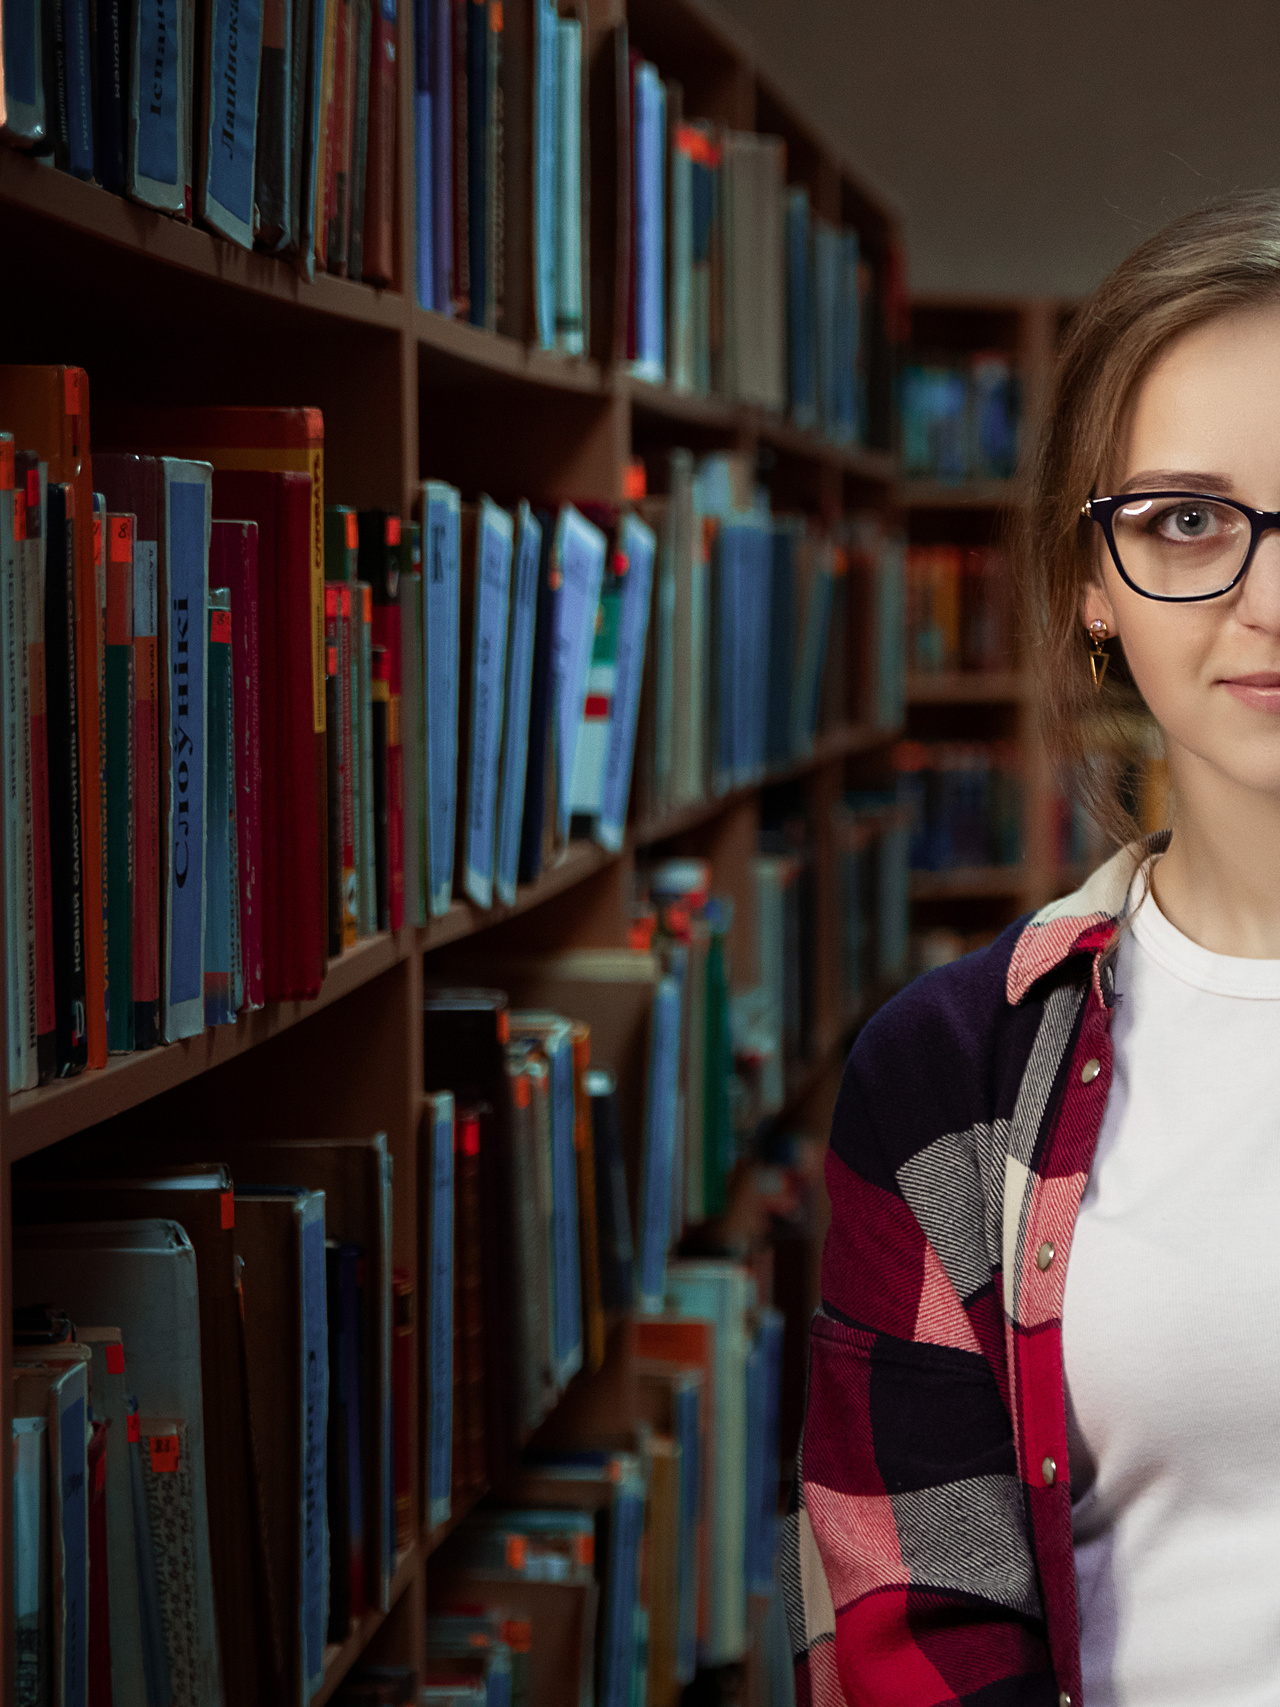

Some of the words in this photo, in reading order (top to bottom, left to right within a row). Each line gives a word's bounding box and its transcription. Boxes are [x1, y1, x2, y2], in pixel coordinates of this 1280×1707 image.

[66, 519, 74, 592] ЯЗЫКА
[67, 600, 77, 727] НЕМЕЦКОГО
[174, 598, 193, 888] Слоўнікі
[69, 730, 80, 886] САМОУЧИТЕЛЬ
[72, 892, 81, 973] НОВЫЙ
[28, 941, 36, 1049] НЕМЕЦКИЕ
